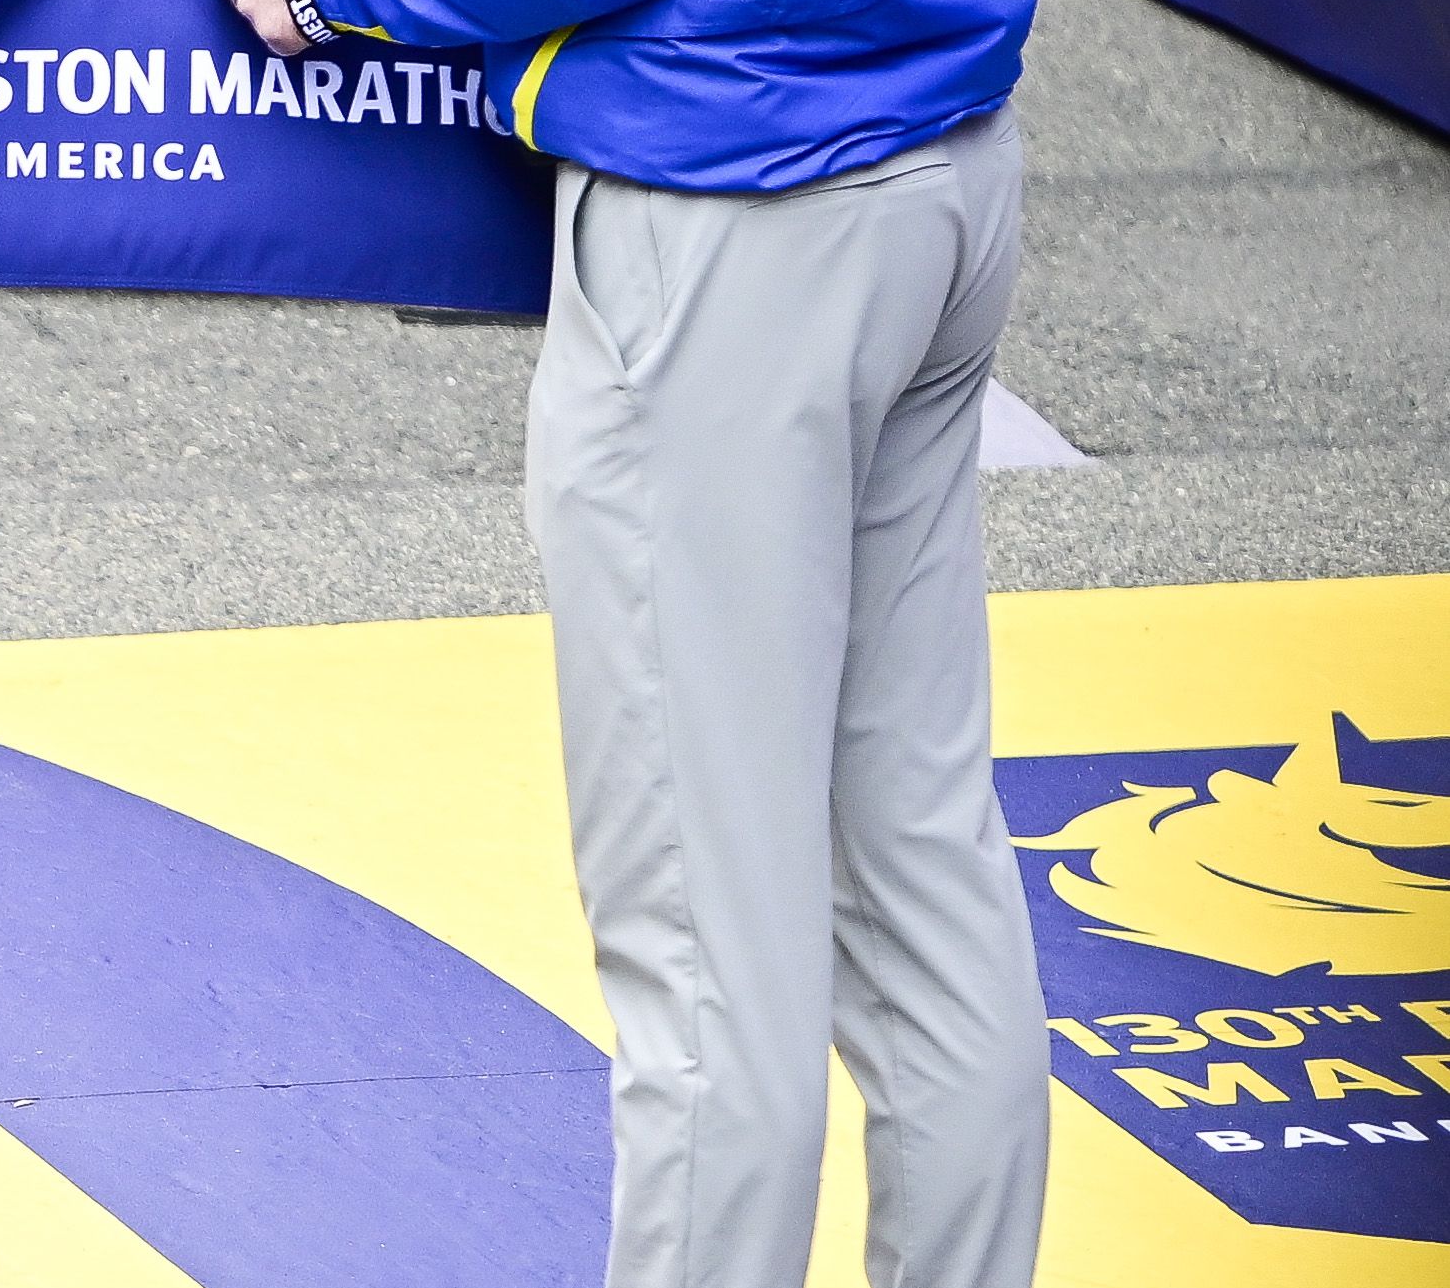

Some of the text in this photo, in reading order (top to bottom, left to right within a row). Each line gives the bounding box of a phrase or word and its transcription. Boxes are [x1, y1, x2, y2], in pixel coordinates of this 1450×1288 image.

[189, 51, 513, 136] MARATH
[1045, 1003, 1382, 1058] 130TH
[1196, 1119, 1450, 1154] BAN
